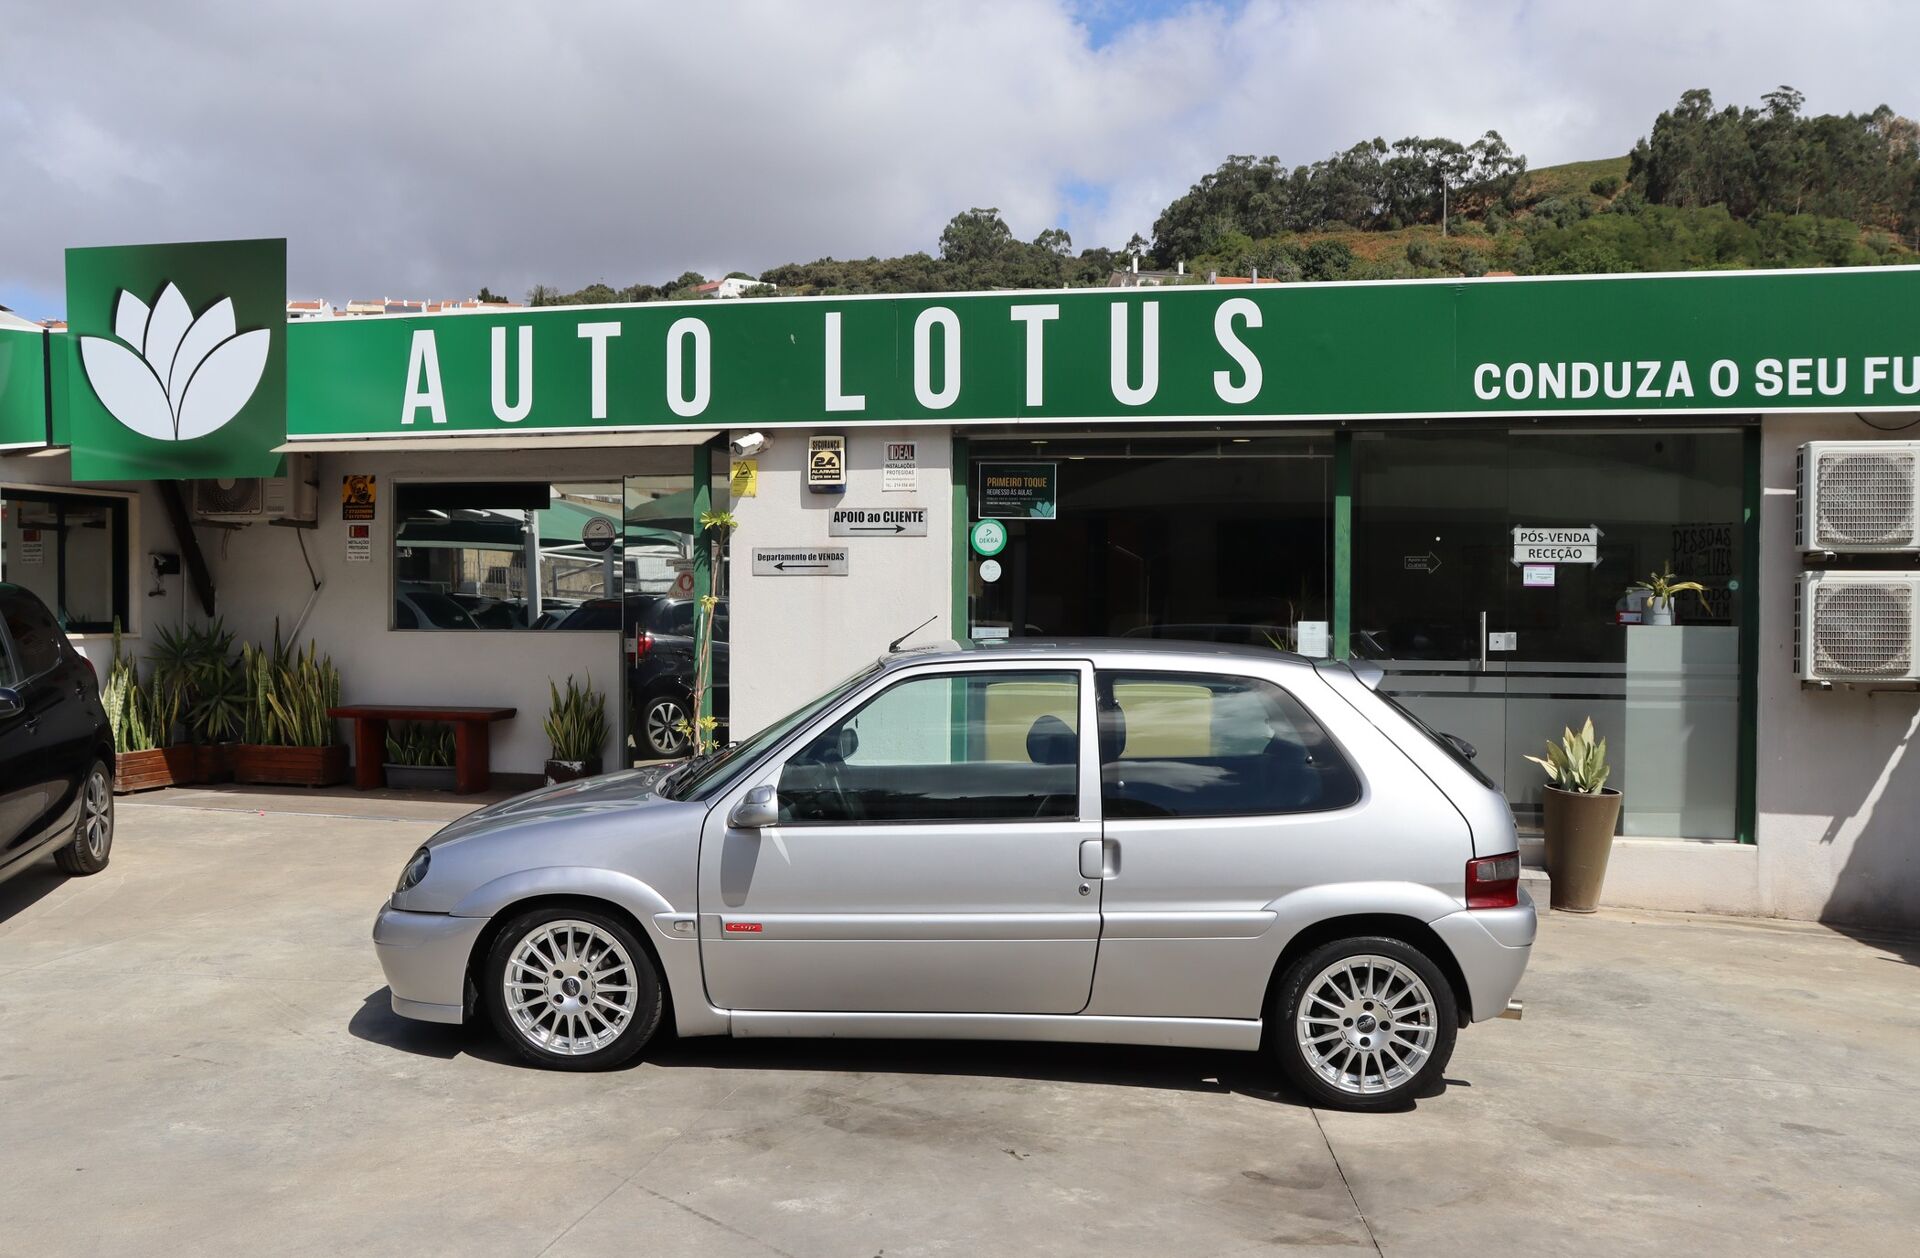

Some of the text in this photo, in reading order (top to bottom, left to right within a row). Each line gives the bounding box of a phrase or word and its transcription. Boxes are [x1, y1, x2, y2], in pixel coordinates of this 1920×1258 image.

[401, 297, 1263, 424] AUTO LOTUS
[1473, 360, 1695, 400] CONDUZA
[1709, 359, 1740, 397] O
[1754, 357, 1848, 396] SEU
[888, 445, 914, 460] IDEAL
[986, 477, 1048, 488] PRIMEIRO TOQUE
[833, 511, 924, 523] APOIO ao CLIENTE
[1520, 530, 1590, 543] PÓS-VENDA
[757, 553, 844, 562] Departamento de VENDAS
[1528, 546, 1583, 561] RECEÇÃO
